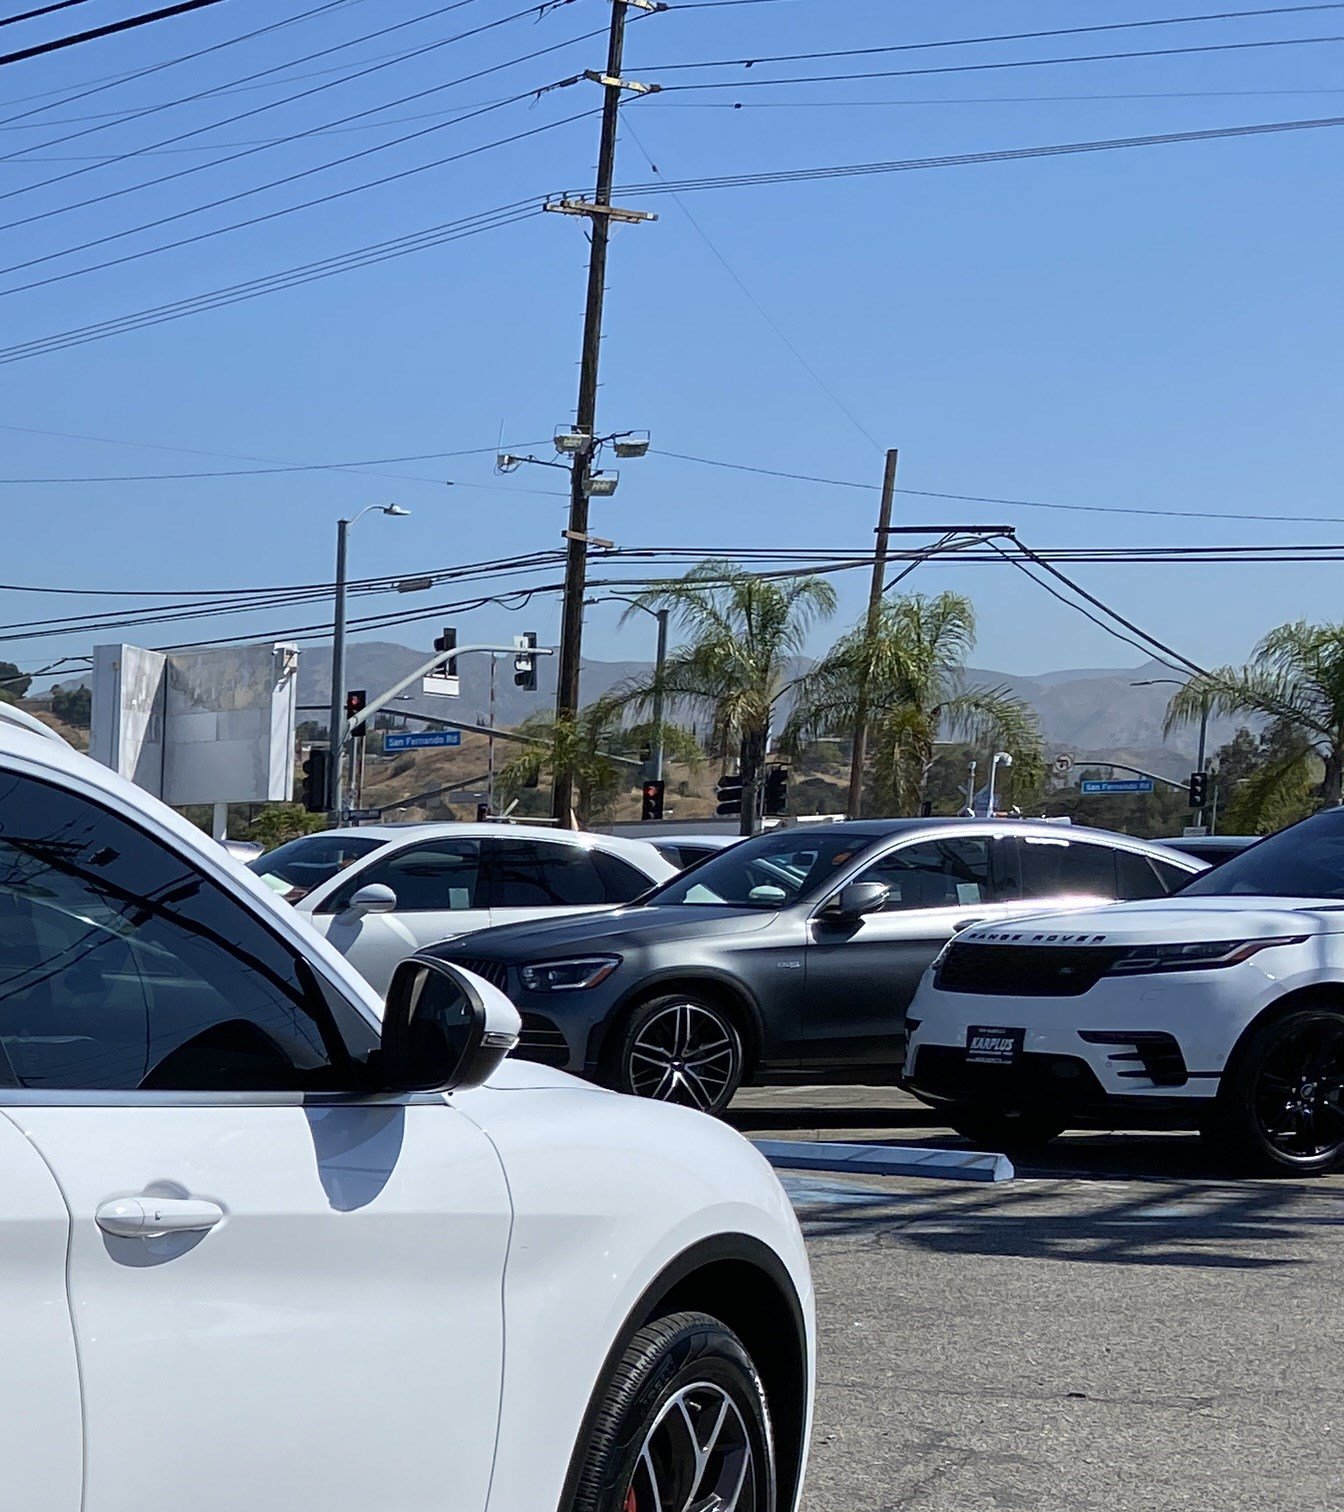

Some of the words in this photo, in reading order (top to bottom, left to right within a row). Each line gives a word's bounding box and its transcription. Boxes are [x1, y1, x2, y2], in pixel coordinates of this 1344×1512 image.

[388, 737, 404, 747] San
[405, 735, 445, 746] Fernando
[446, 734, 459, 744] Rd
[1085, 783, 1101, 792] San
[968, 933, 1023, 942] RANGE
[1031, 934, 1107, 943] ROVER
[969, 1036, 1015, 1051] KARPLUS
